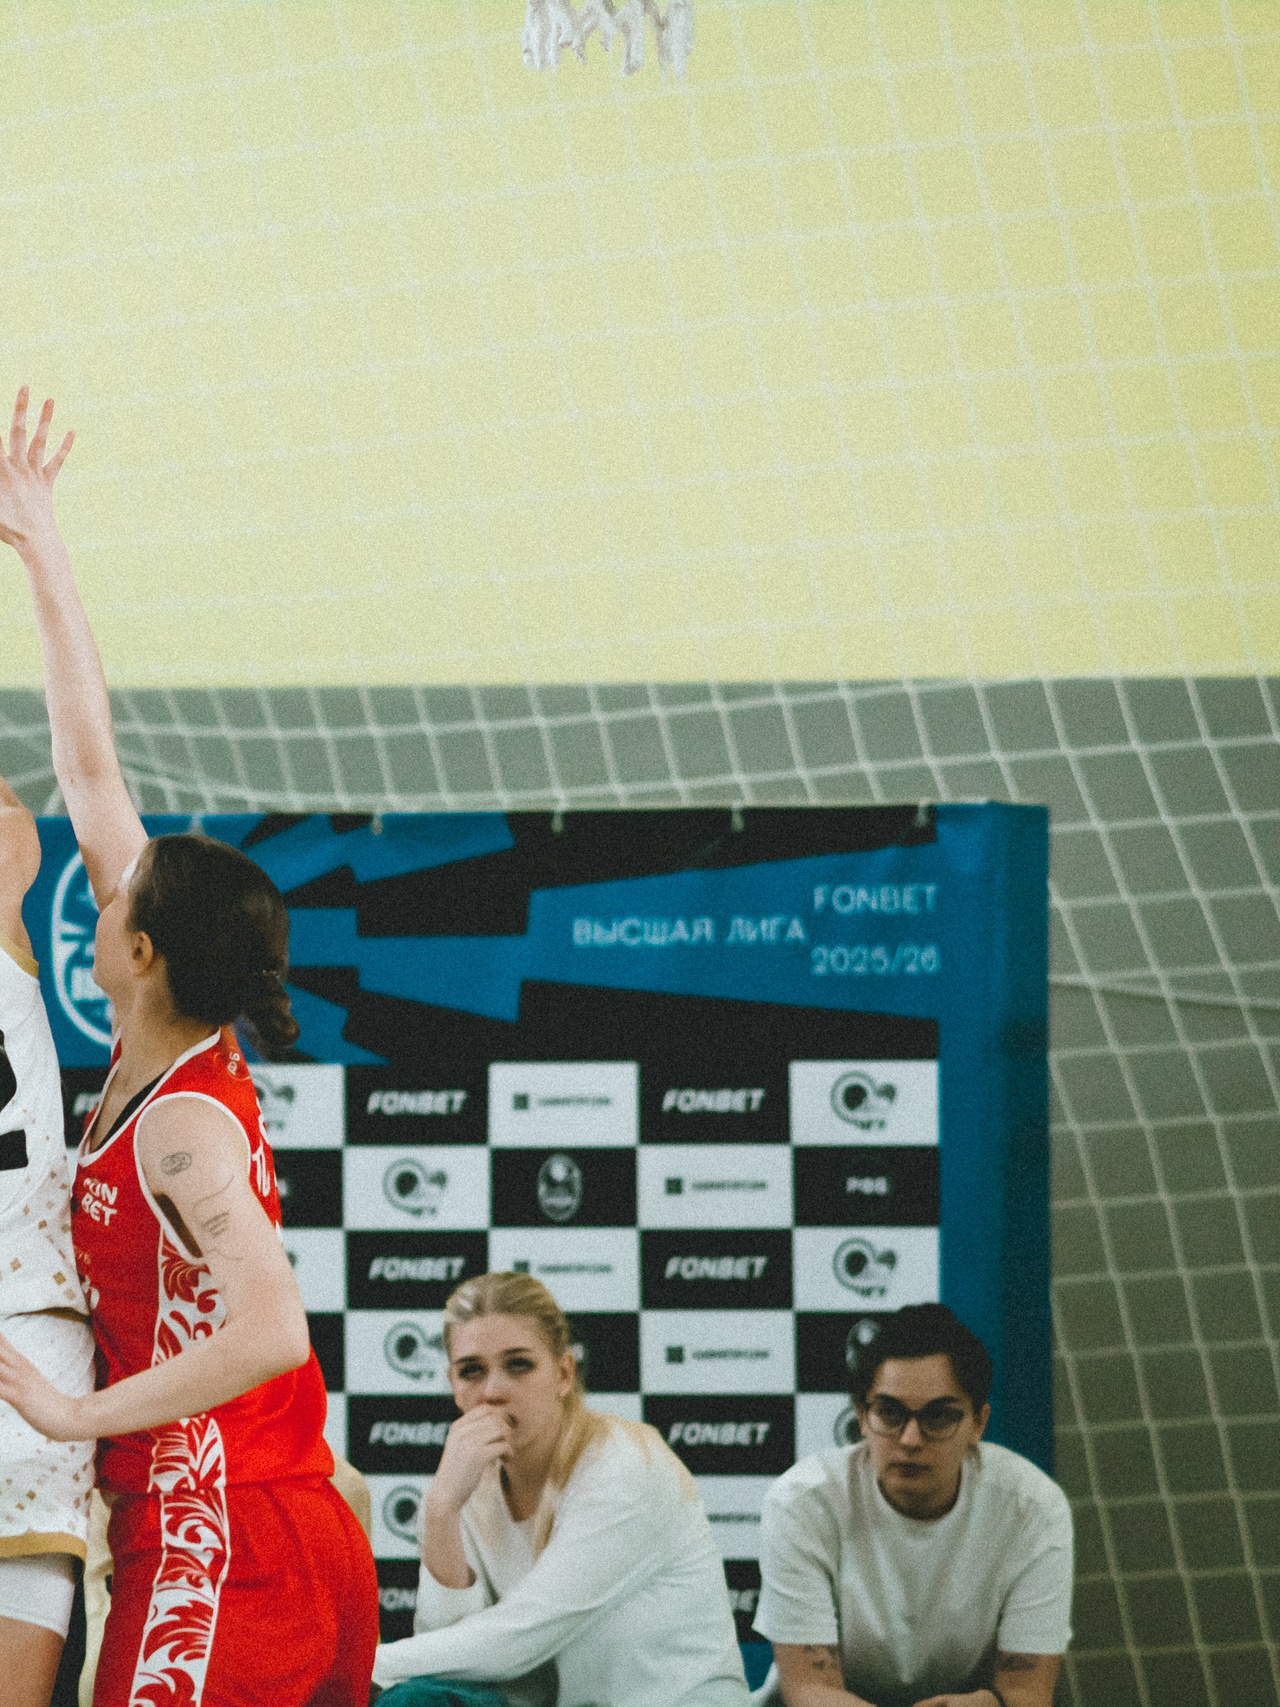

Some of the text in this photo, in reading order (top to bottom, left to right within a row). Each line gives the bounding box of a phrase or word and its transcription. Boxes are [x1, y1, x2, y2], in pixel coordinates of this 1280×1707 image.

[813, 884, 938, 914] FONBET
[572, 914, 807, 947] ВЫСШАЯ ЛИГА
[367, 1090, 467, 1116] FONBET
[662, 1087, 765, 1113] FONBET
[81, 1192, 118, 1226] BET
[369, 1256, 465, 1281] FONBET
[665, 1256, 768, 1281] FONBET
[668, 1422, 771, 1446] FONBET
